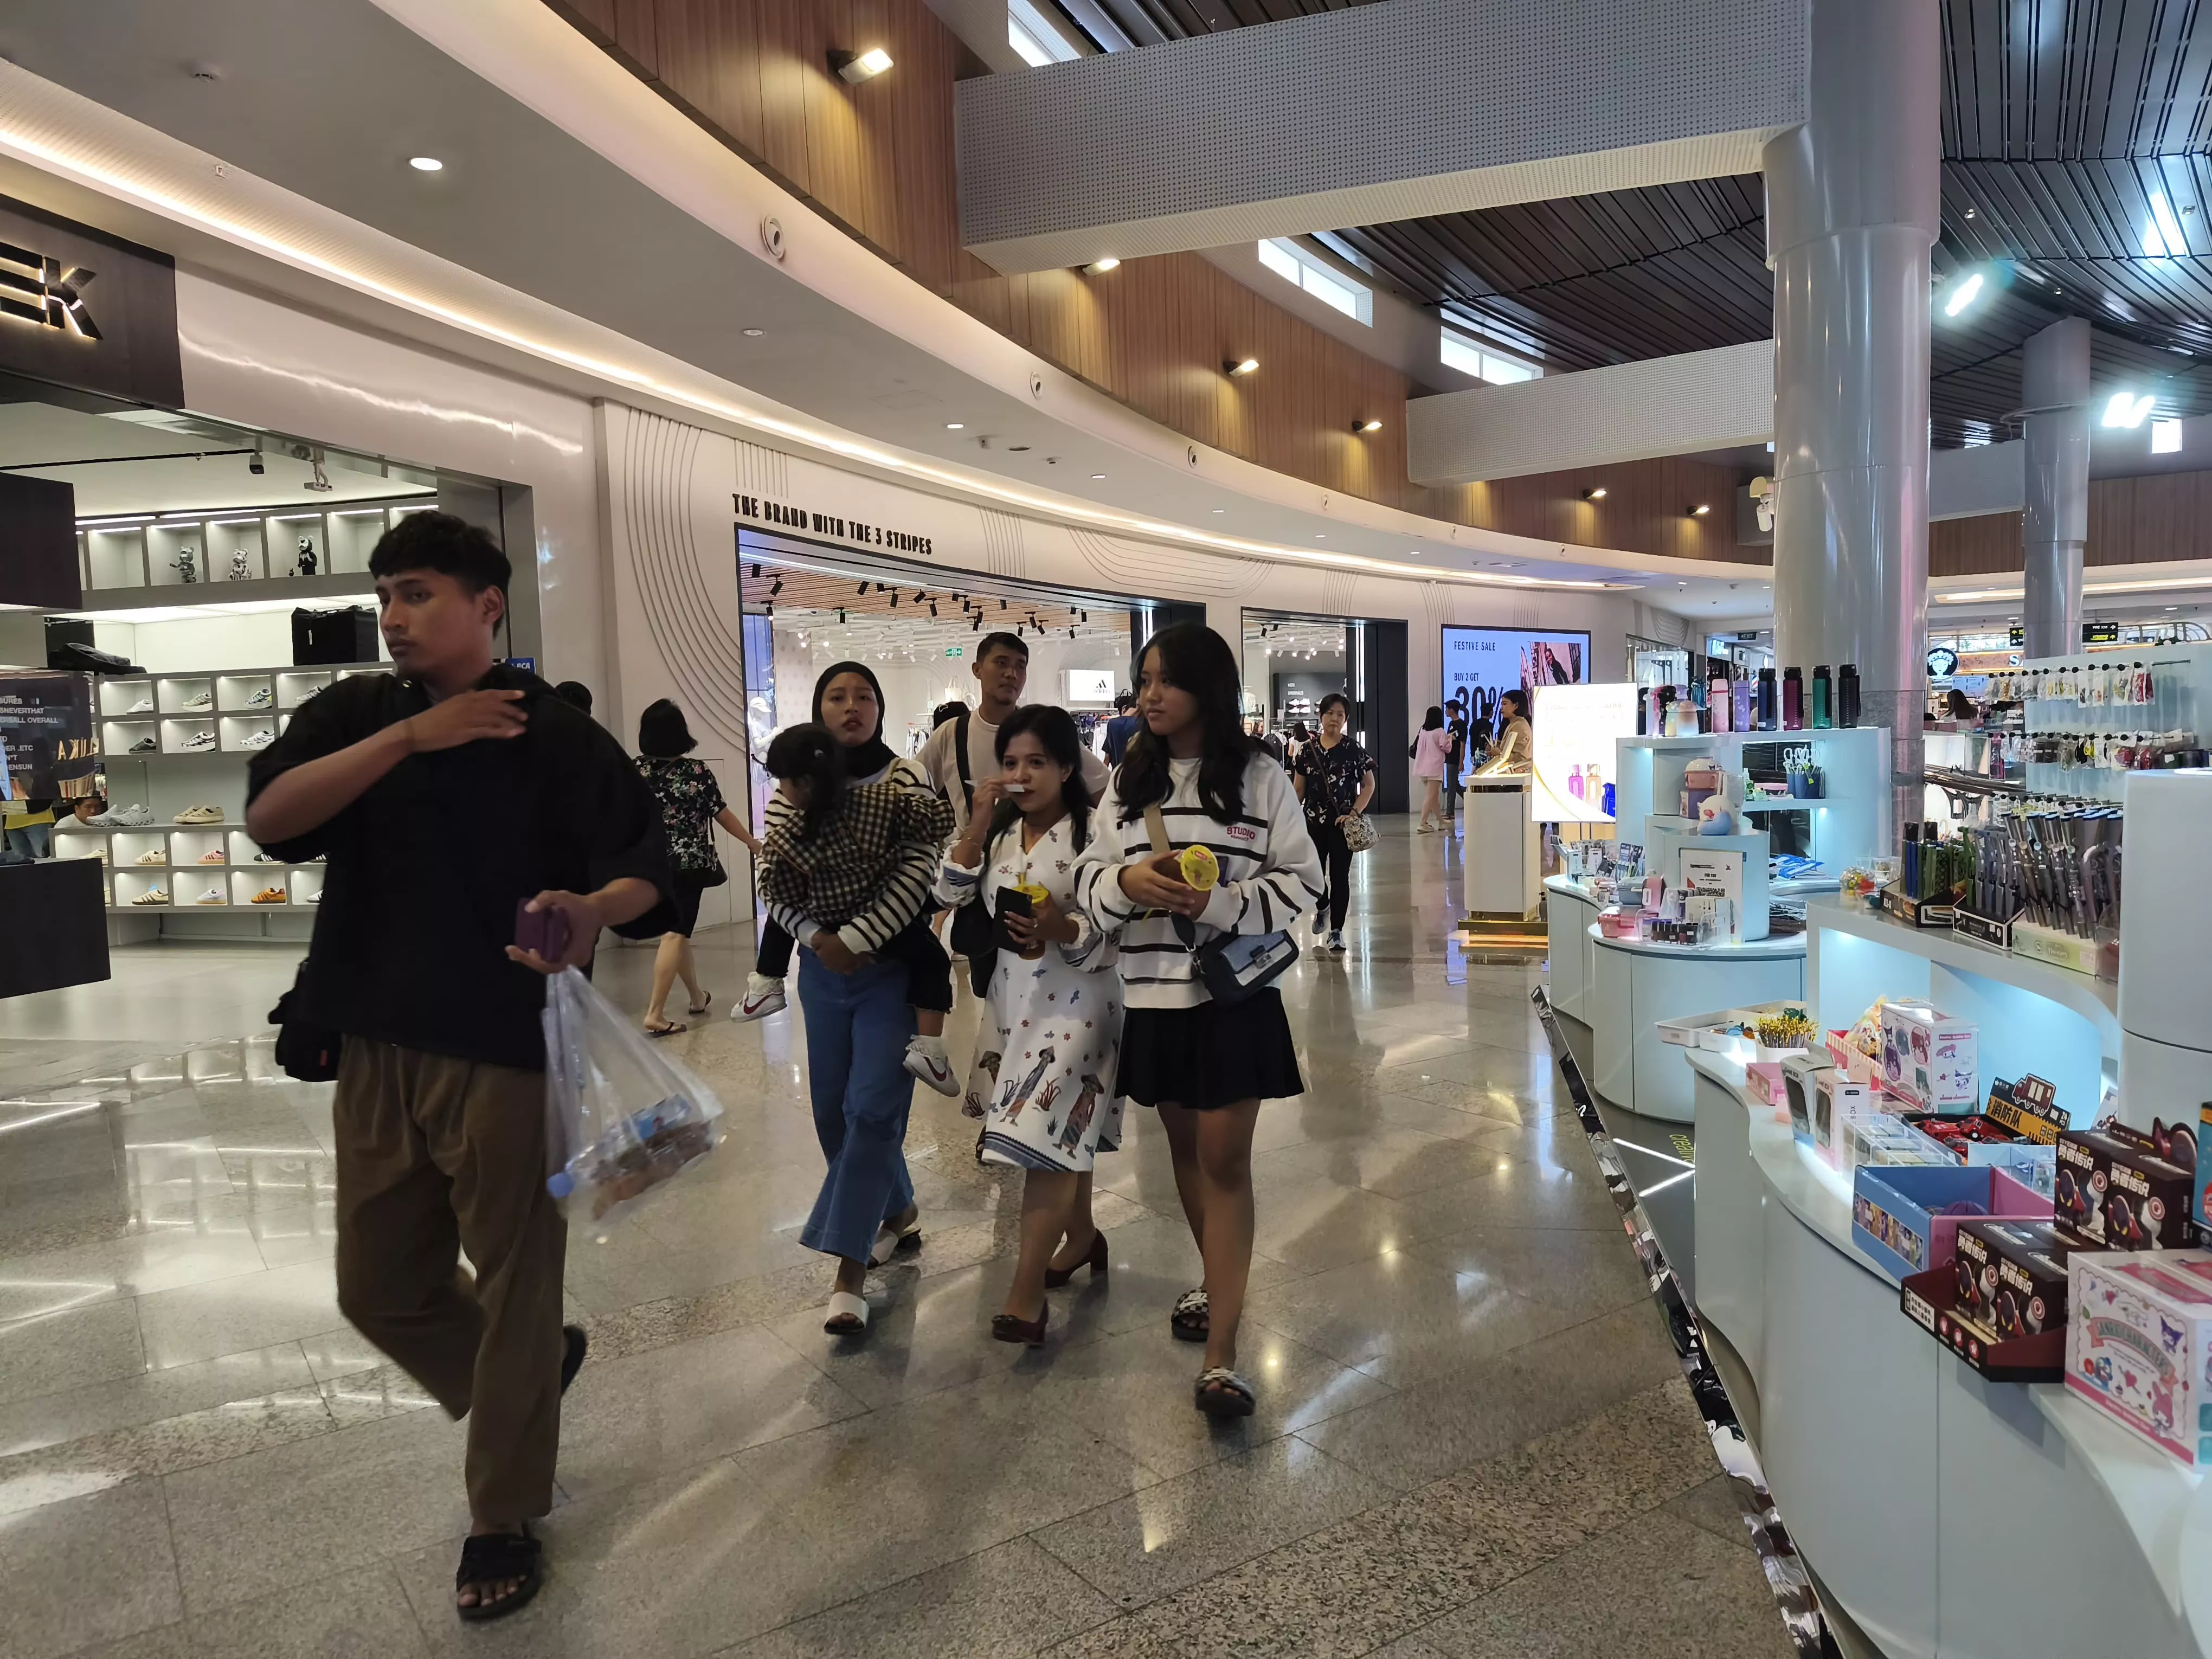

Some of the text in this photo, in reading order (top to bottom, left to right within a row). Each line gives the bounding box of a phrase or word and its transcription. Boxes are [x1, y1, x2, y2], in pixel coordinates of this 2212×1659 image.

[732, 493, 931, 555] THE BRAND WITH THE 3 STRIPES
[1454, 641, 1496, 651] FESTIVE SALE
[1454, 673, 1464, 681] BUY
[1470, 673, 1479, 681] GET
[1227, 827, 1256, 840] STUDIO
[1991, 1099, 2022, 1129] 消防队
